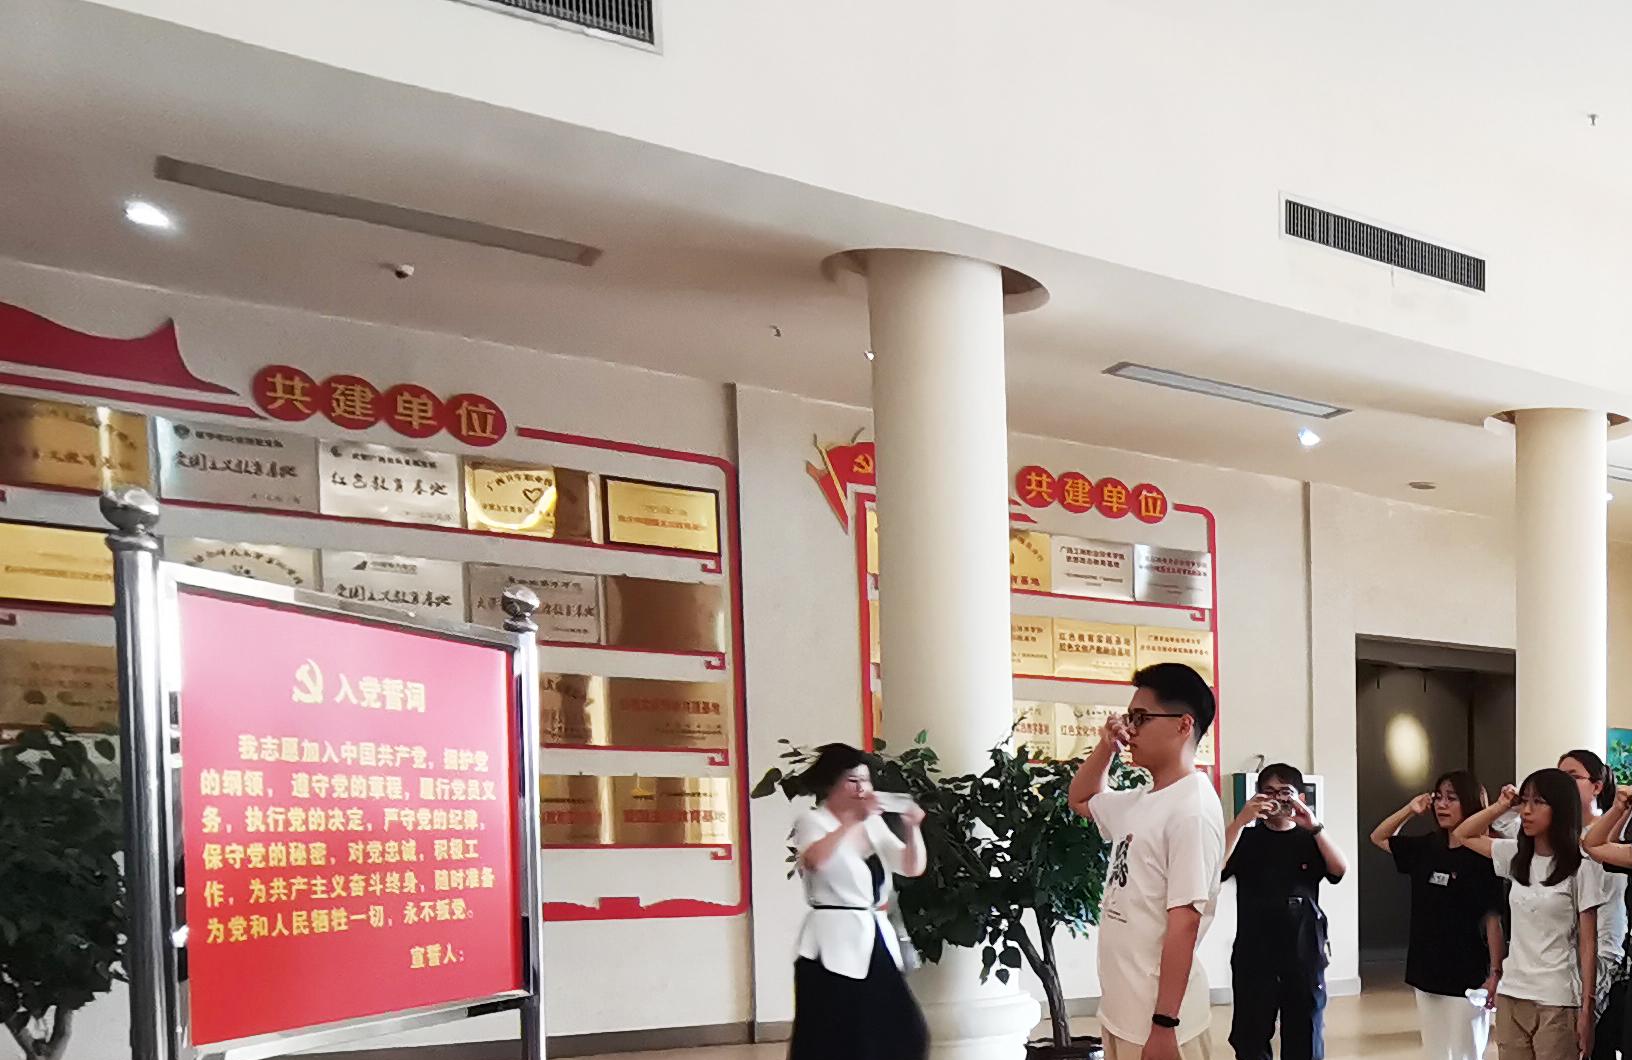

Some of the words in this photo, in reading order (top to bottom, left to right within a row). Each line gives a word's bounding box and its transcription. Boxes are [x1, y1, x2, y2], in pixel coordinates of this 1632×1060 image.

[266, 373, 499, 439] 共建单位
[1025, 472, 1164, 518] 共建单位
[334, 673, 426, 713] 入党誓词
